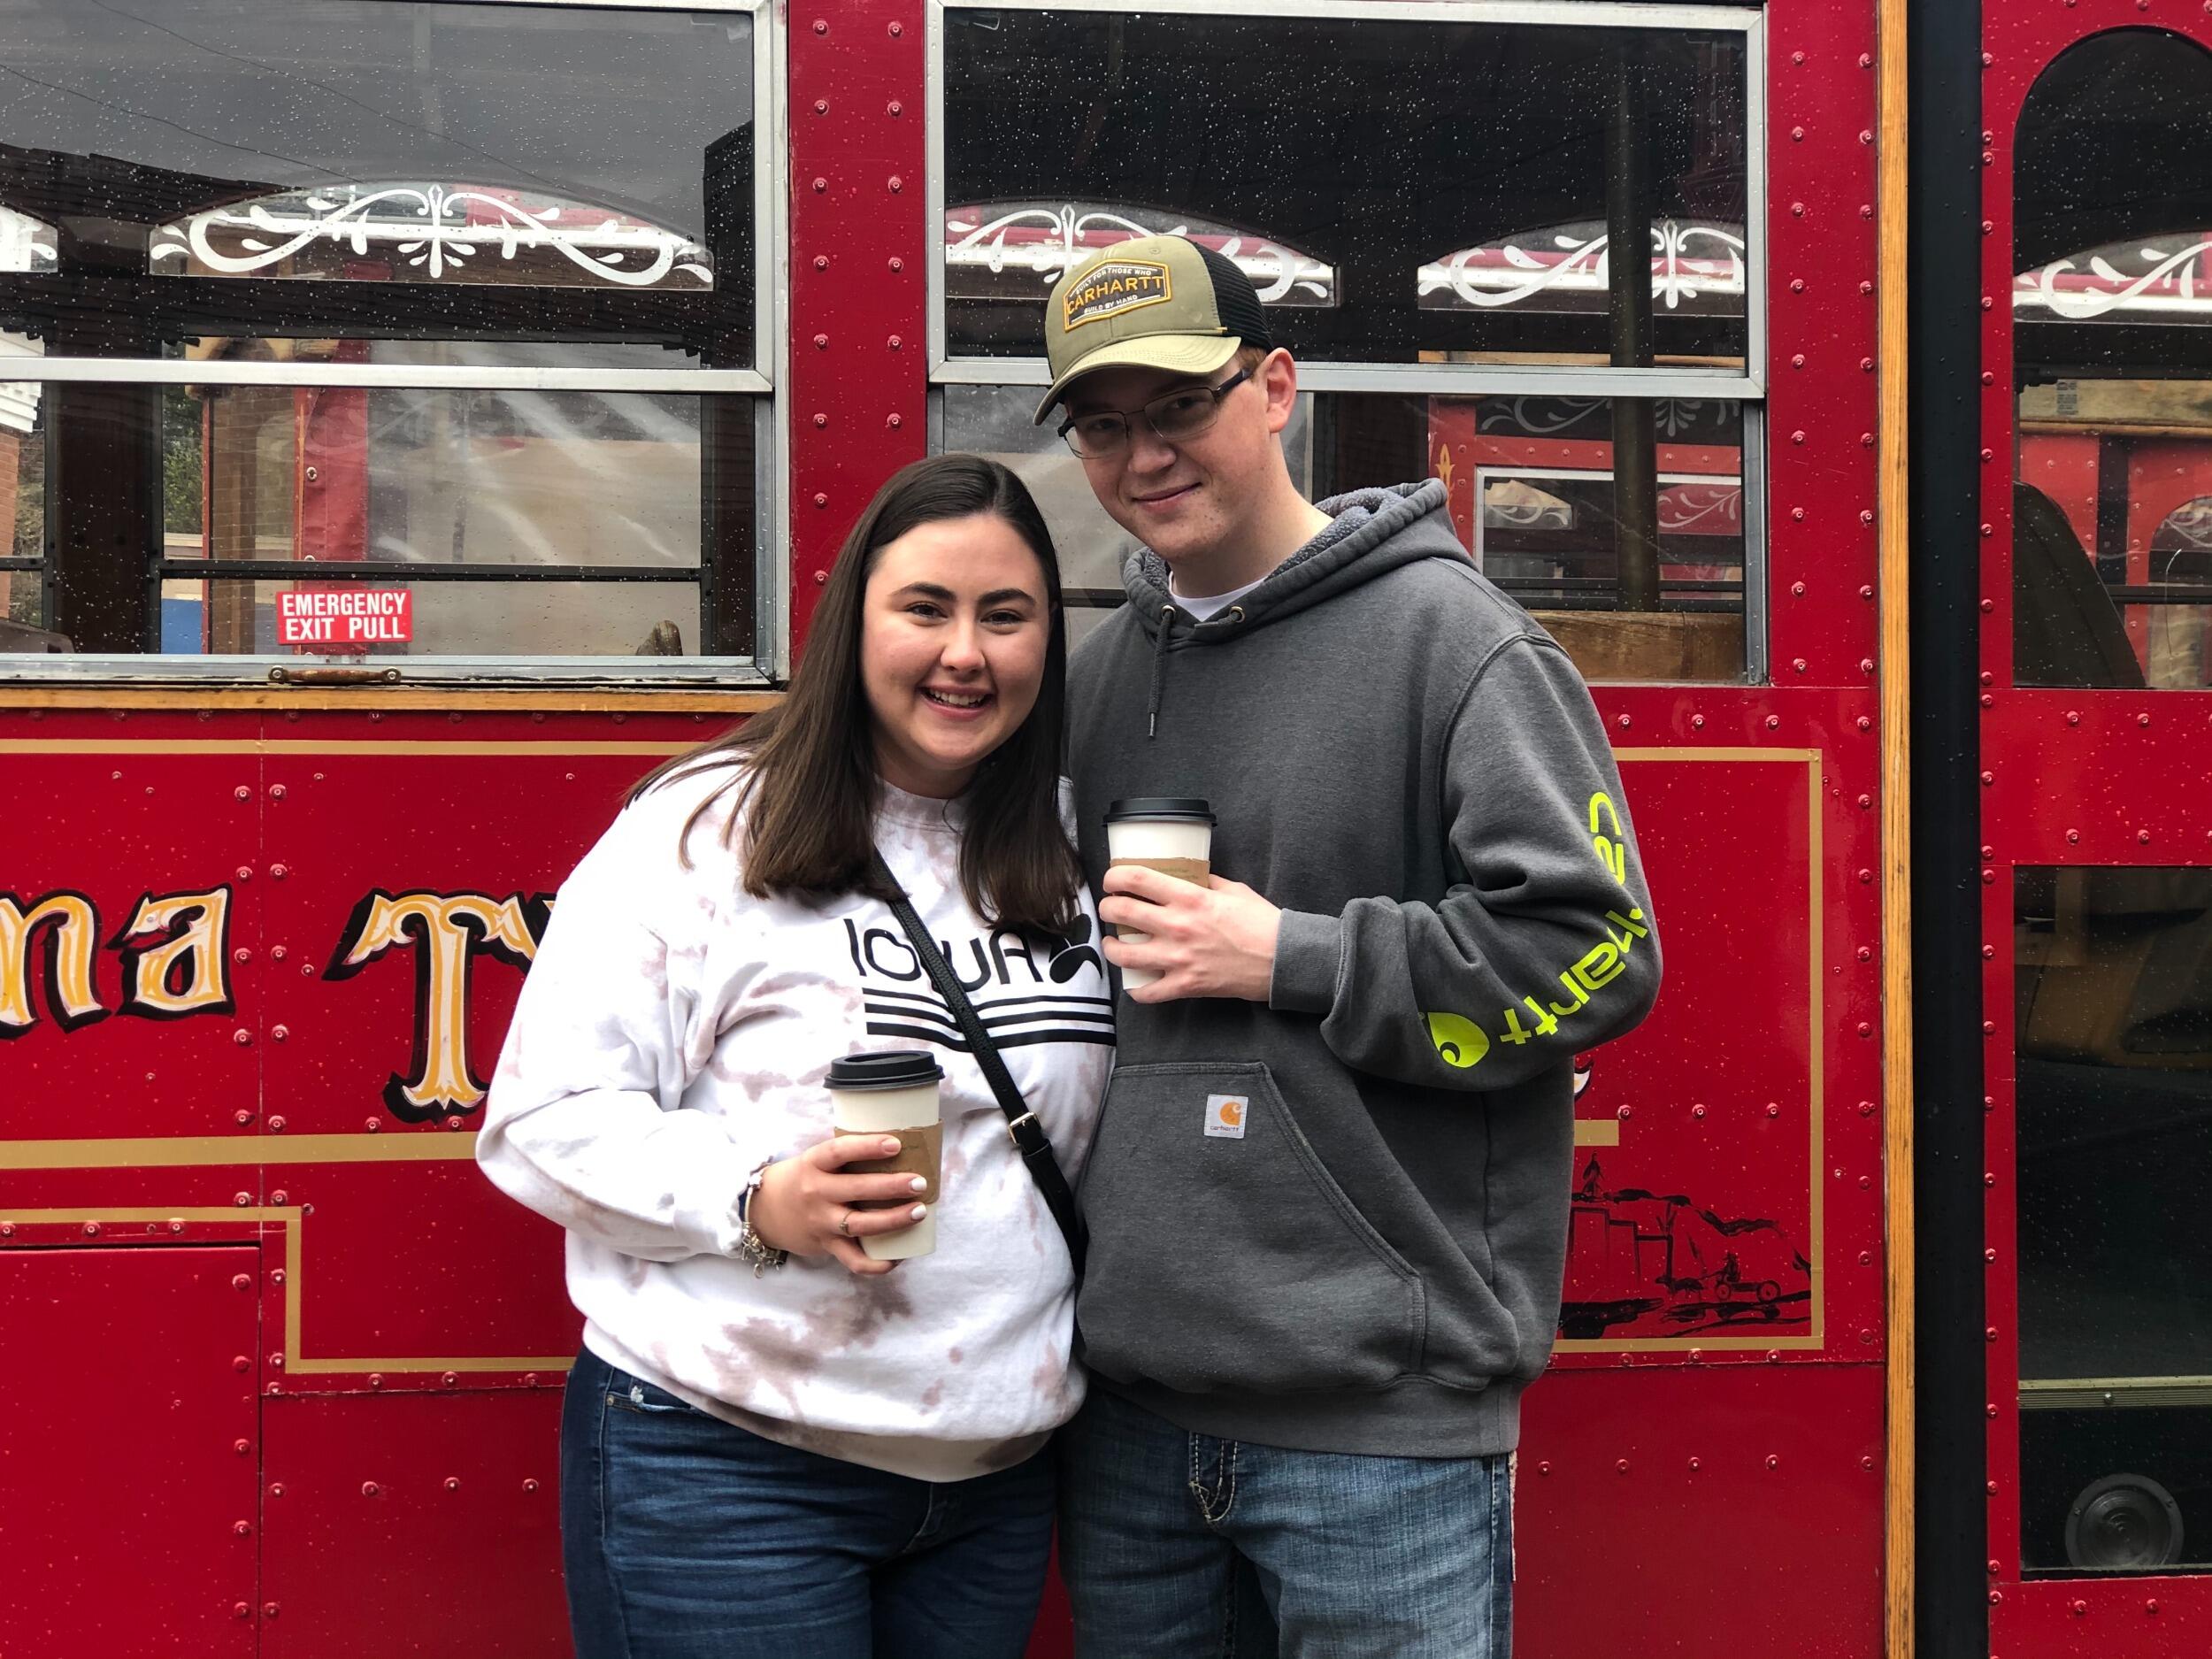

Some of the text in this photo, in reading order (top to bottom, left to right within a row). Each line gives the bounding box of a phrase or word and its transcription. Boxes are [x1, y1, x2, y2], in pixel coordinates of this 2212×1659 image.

[1094, 271, 1107, 280] FOR
[1067, 276, 1164, 314] CARHARTT
[1104, 301, 1115, 310] BY
[1116, 294, 1138, 305] HAND
[282, 592, 406, 617] EMERGENCY
[286, 617, 405, 641] EXIT PULL
